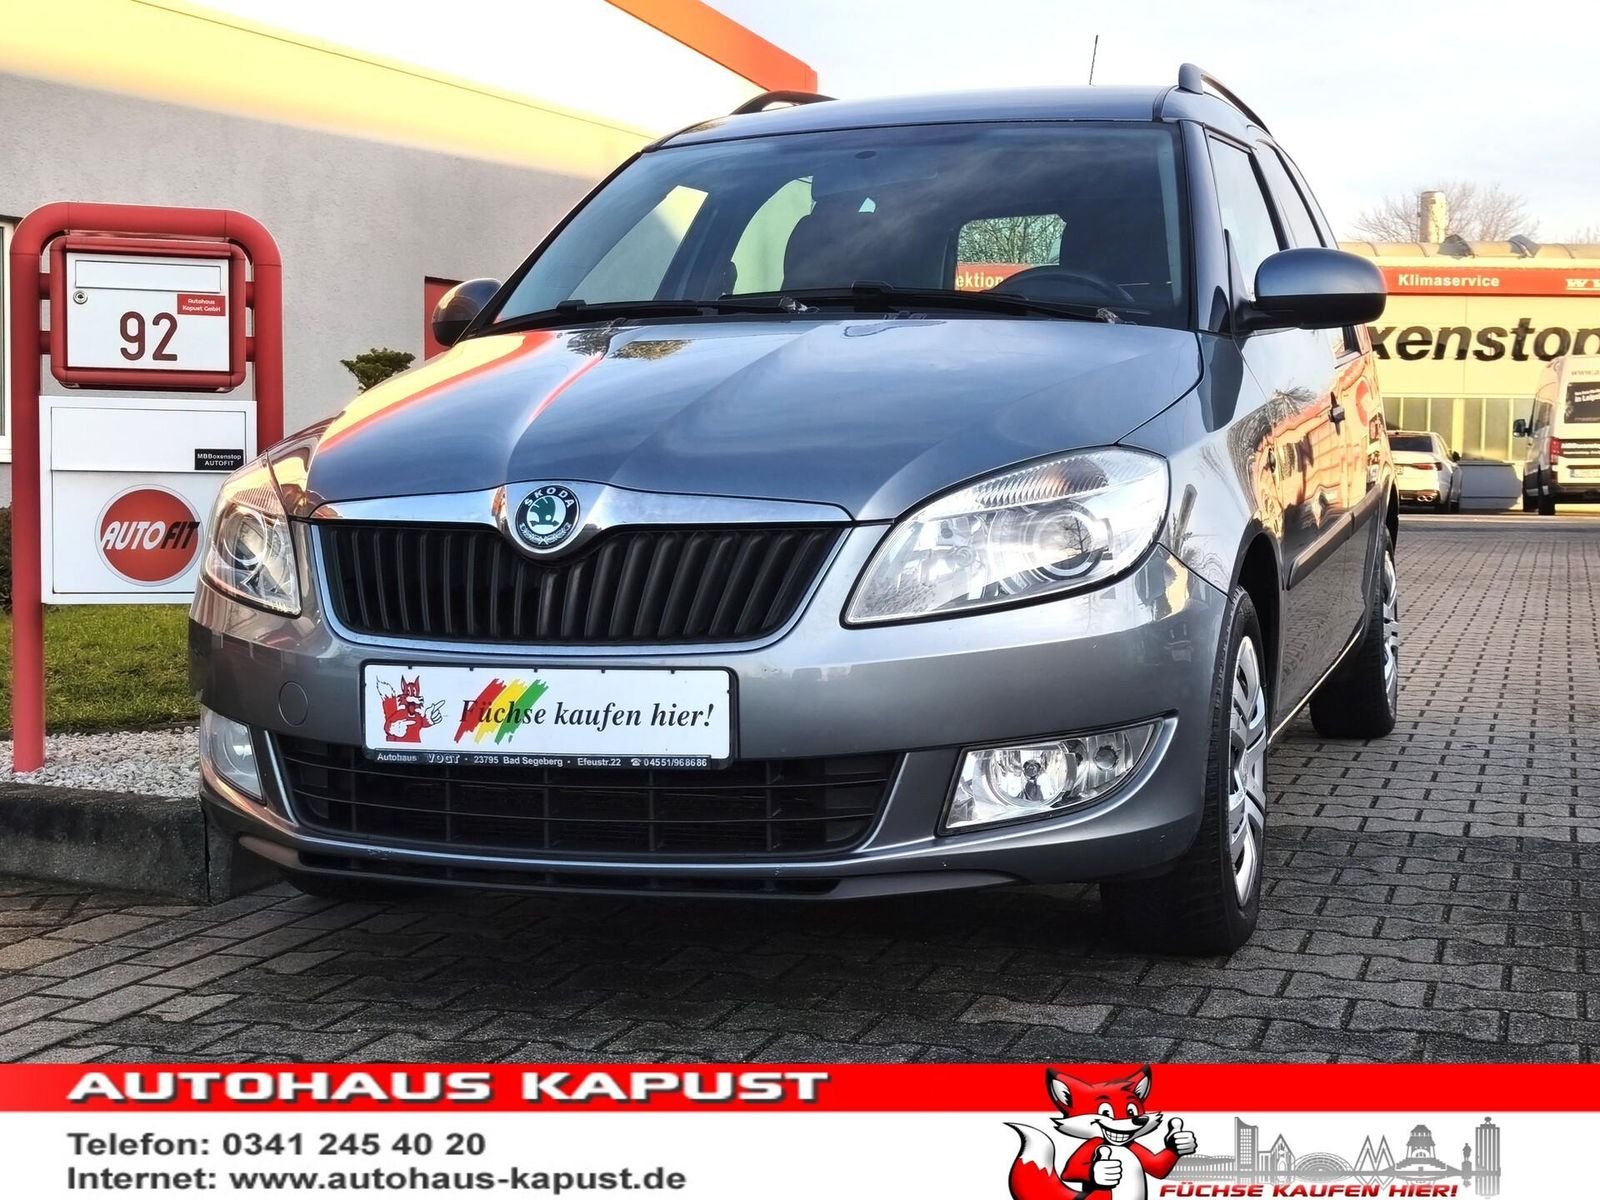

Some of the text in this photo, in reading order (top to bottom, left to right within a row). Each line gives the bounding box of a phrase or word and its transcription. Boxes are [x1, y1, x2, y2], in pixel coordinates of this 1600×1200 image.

[1398, 274, 1500, 288] Klimaservice
[119, 311, 178, 362] 92
[101, 521, 200, 550] AUTOFIT
[460, 699, 714, 732] Füchse kaufen hier!
[376, 752, 417, 762] Autohaus
[473, 755, 499, 764] 23795
[502, 756, 520, 764] Bad
[522, 756, 563, 767] Segeberg
[643, 758, 708, 767] 04551/968686
